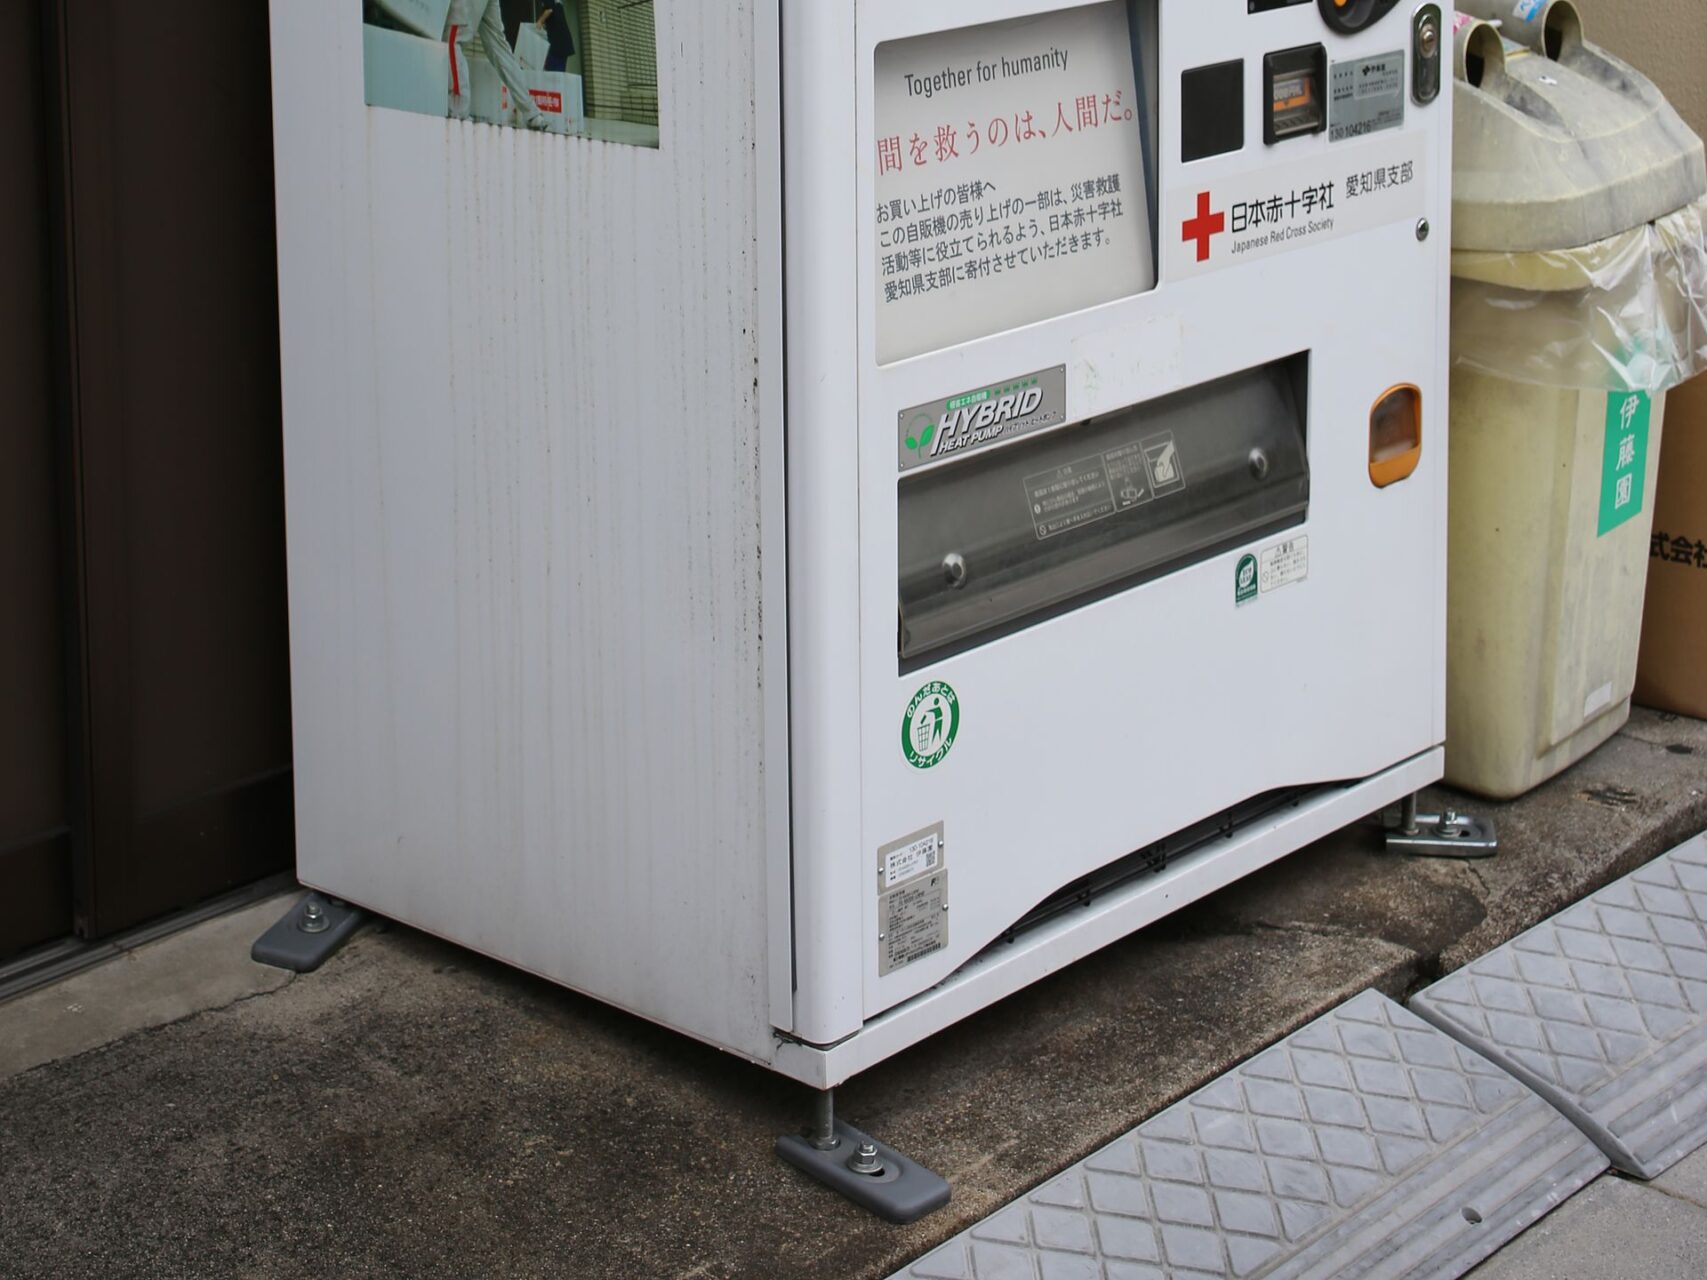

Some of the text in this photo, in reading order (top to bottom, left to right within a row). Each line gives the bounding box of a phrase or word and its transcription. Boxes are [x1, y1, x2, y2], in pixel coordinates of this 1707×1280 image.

[904, 47, 1069, 99] Together for humanity
[877, 90, 1133, 176] 間を救うのは、人間だ。
[876, 179, 996, 223] お買い上げの皆様へ
[879, 173, 1121, 248] この自販機の売り上げの一部は、災害救護
[1231, 160, 1414, 234] 日本赤十字社 愛知県支部
[881, 198, 1124, 277] 活動等に役立てられるよう、日本赤十字社
[884, 228, 1111, 304] 愛知県支部に寄付させていただきます。
[1231, 216, 1335, 255] Japanese Red Cross Society
[930, 387, 1043, 457] HYBRID
[938, 425, 1005, 456] HEAT PUMP
[1614, 394, 1640, 510] 伊藤園
[906, 681, 956, 719] のんだあとは
[909, 736, 953, 769] リサイクル
